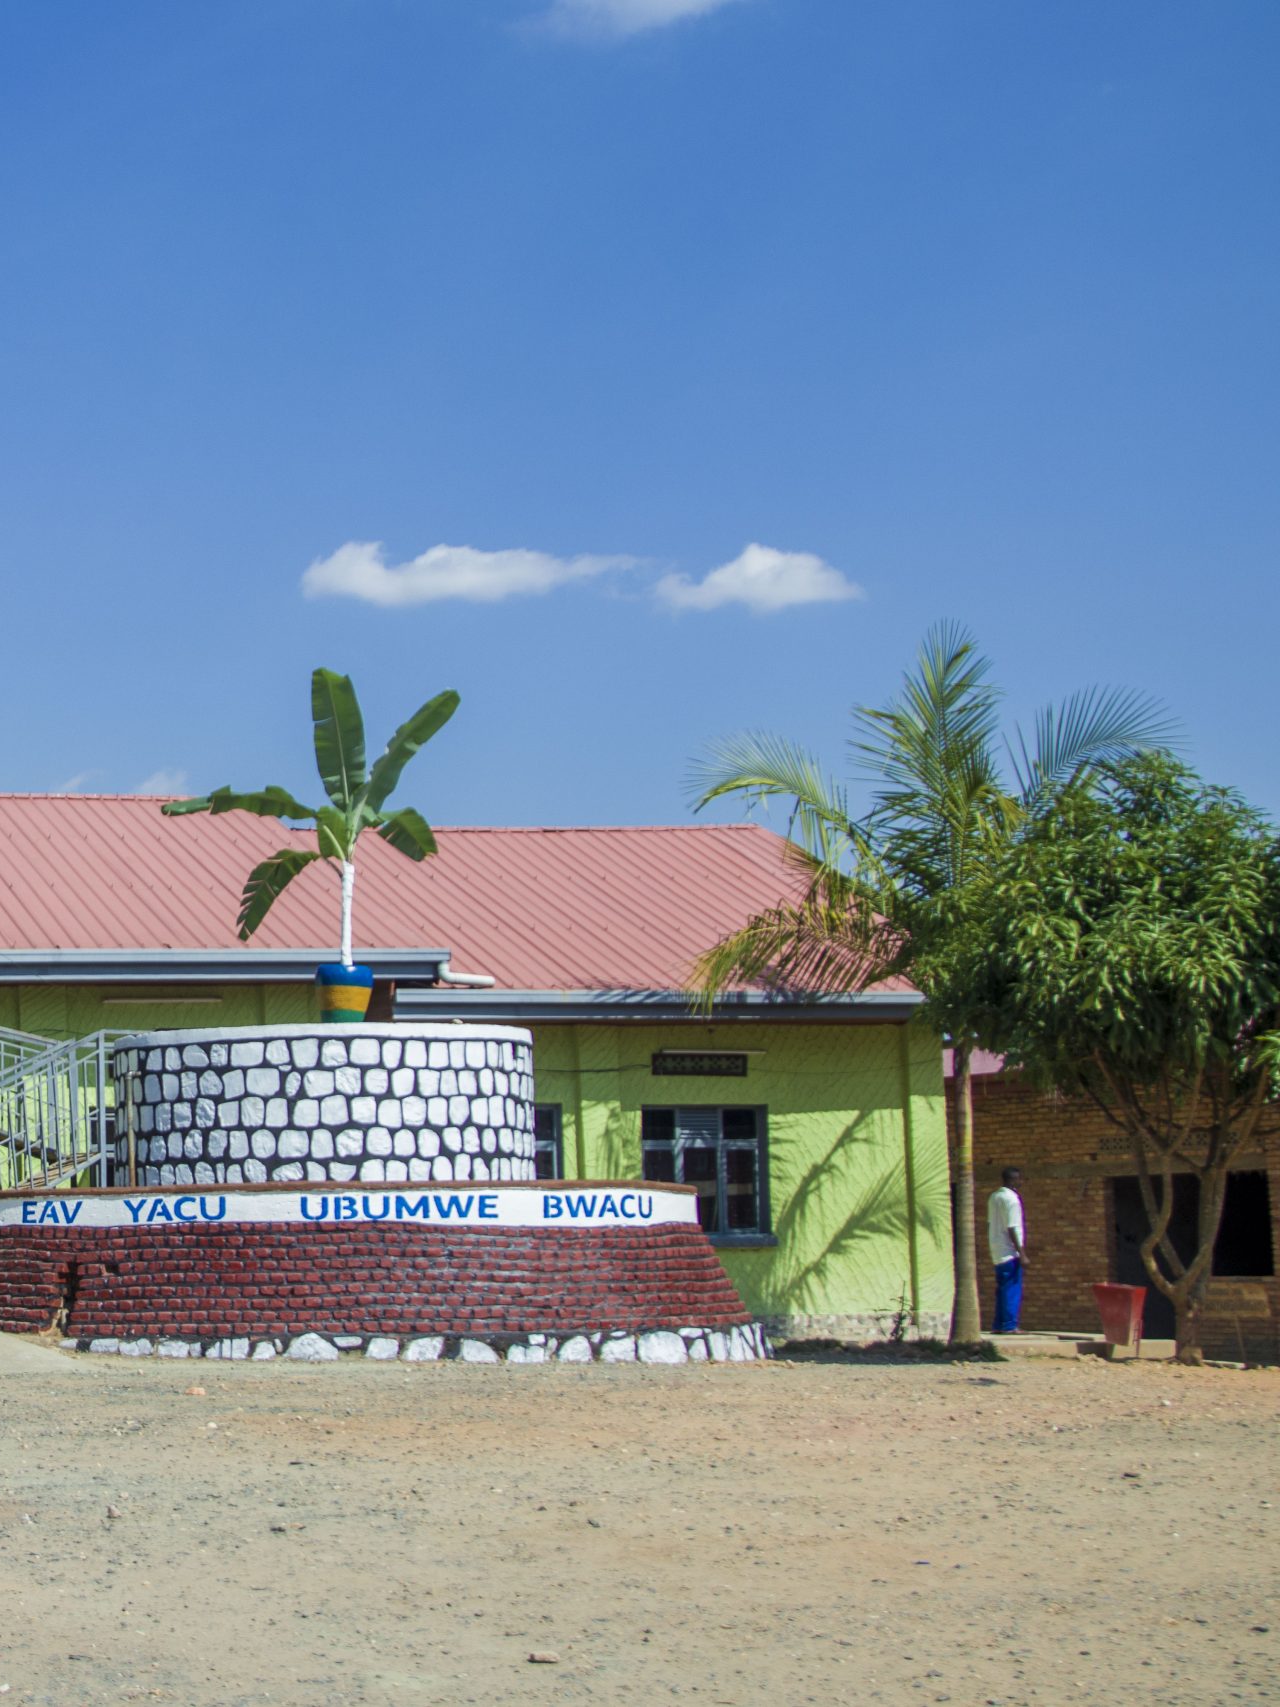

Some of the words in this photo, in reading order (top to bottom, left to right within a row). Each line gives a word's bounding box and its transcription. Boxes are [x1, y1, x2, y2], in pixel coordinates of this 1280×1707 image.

[21, 1200, 83, 1224] EAV
[123, 1196, 227, 1222] YACU
[300, 1195, 498, 1220] UBUMWE
[543, 1194, 653, 1219] BWACU
